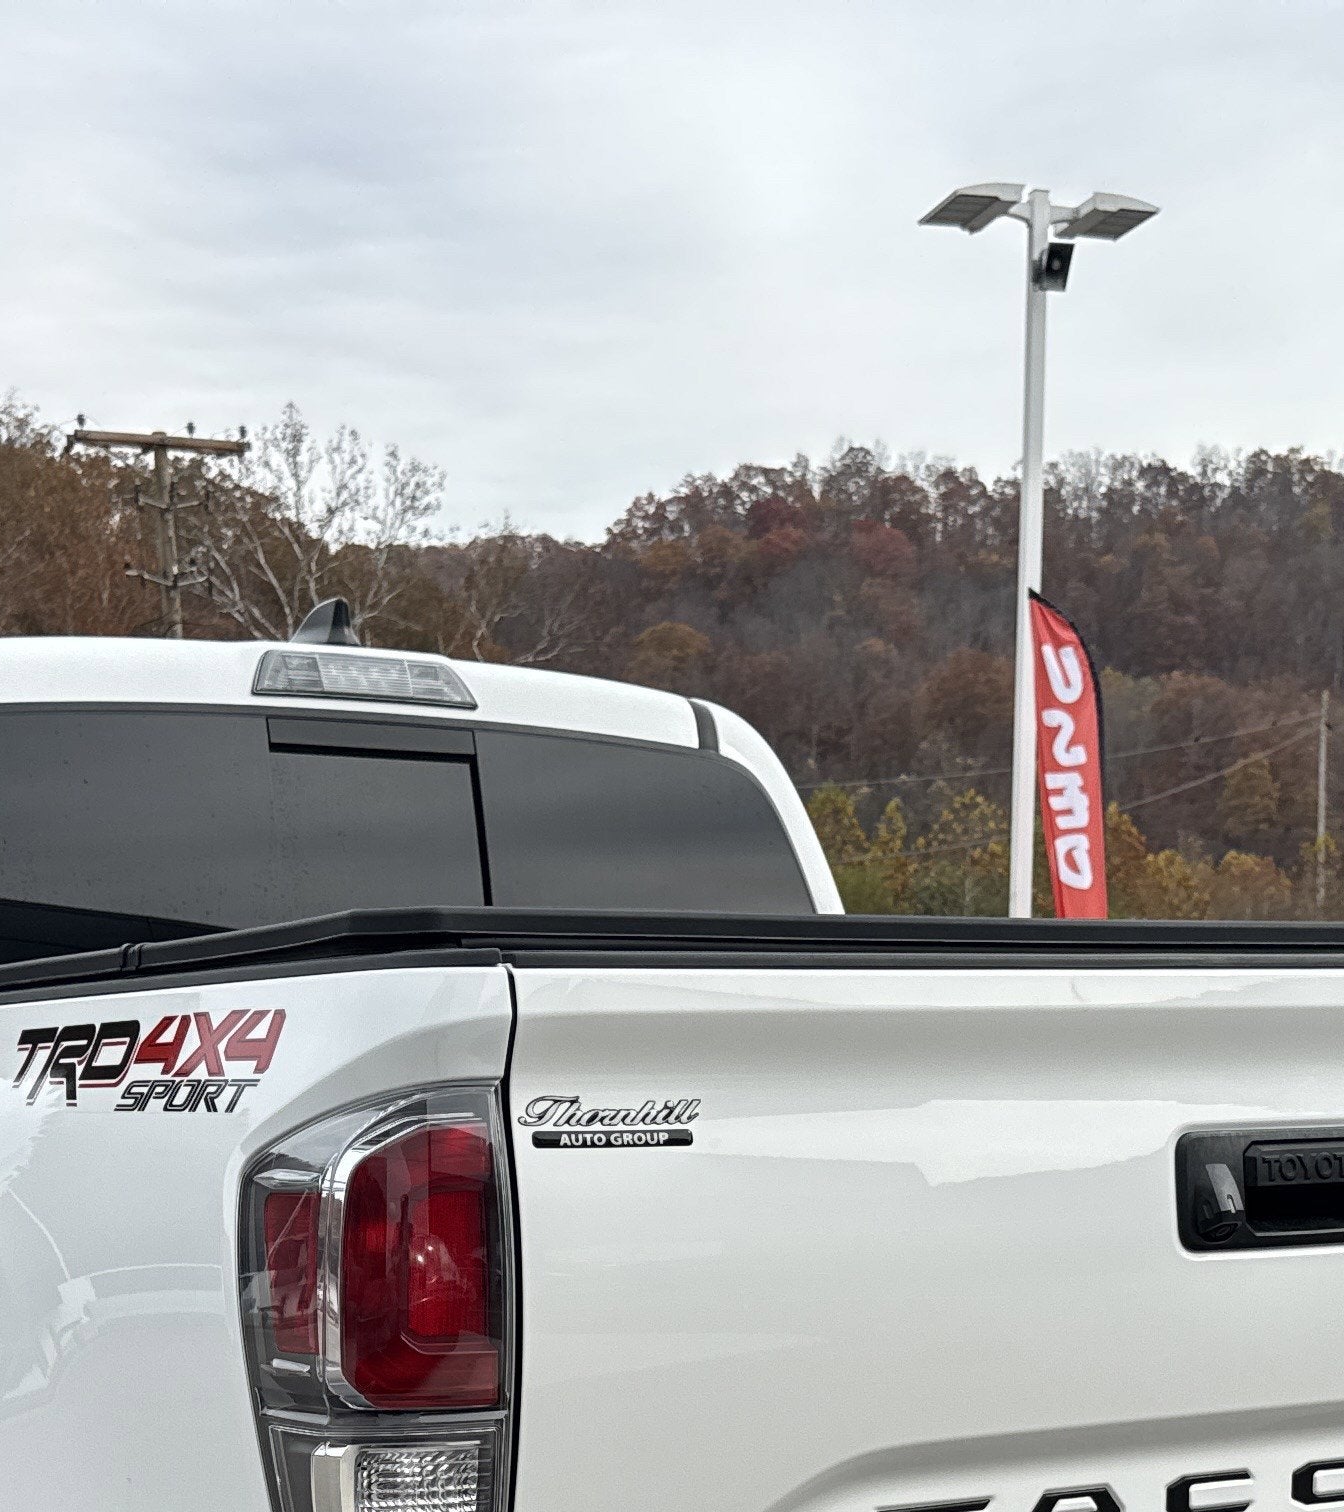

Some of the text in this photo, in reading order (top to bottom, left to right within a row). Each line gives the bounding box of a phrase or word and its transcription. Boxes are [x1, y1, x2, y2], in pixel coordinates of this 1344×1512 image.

[12, 1009, 287, 1107] TRD 4X4
[113, 1079, 261, 1113] SPORT
[517, 1095, 701, 1127] Thornhill
[559, 1131, 669, 1147] AUTO GROUP
